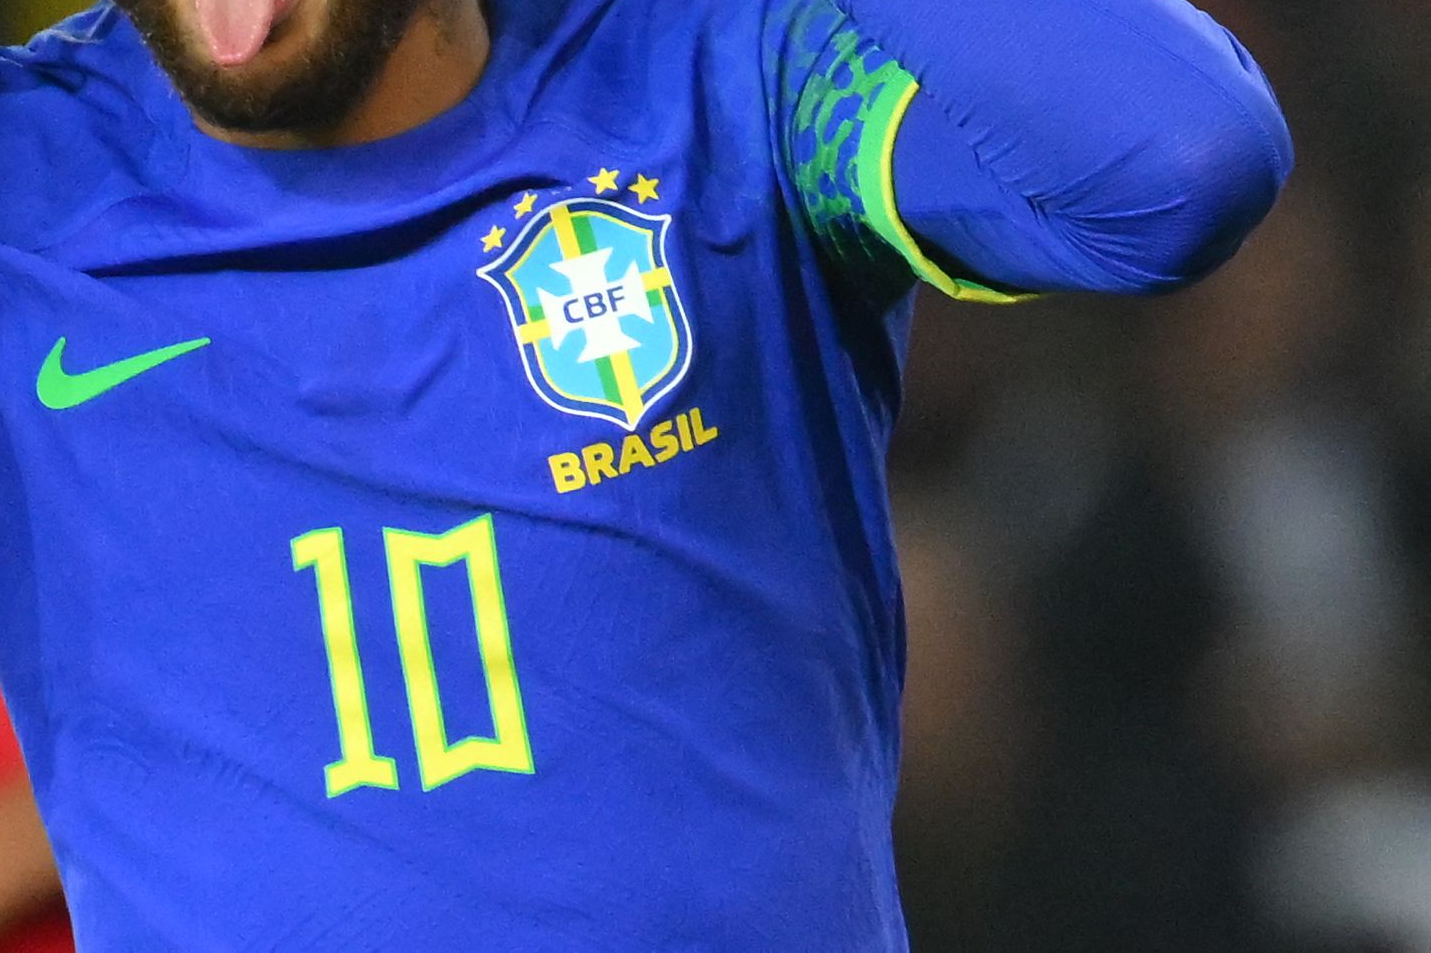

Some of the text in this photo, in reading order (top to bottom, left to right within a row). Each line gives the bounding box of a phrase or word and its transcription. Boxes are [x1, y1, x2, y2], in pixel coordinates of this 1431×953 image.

[563, 286, 627, 324] CBF
[548, 407, 718, 493] BRASIL
[290, 512, 536, 799] 10
